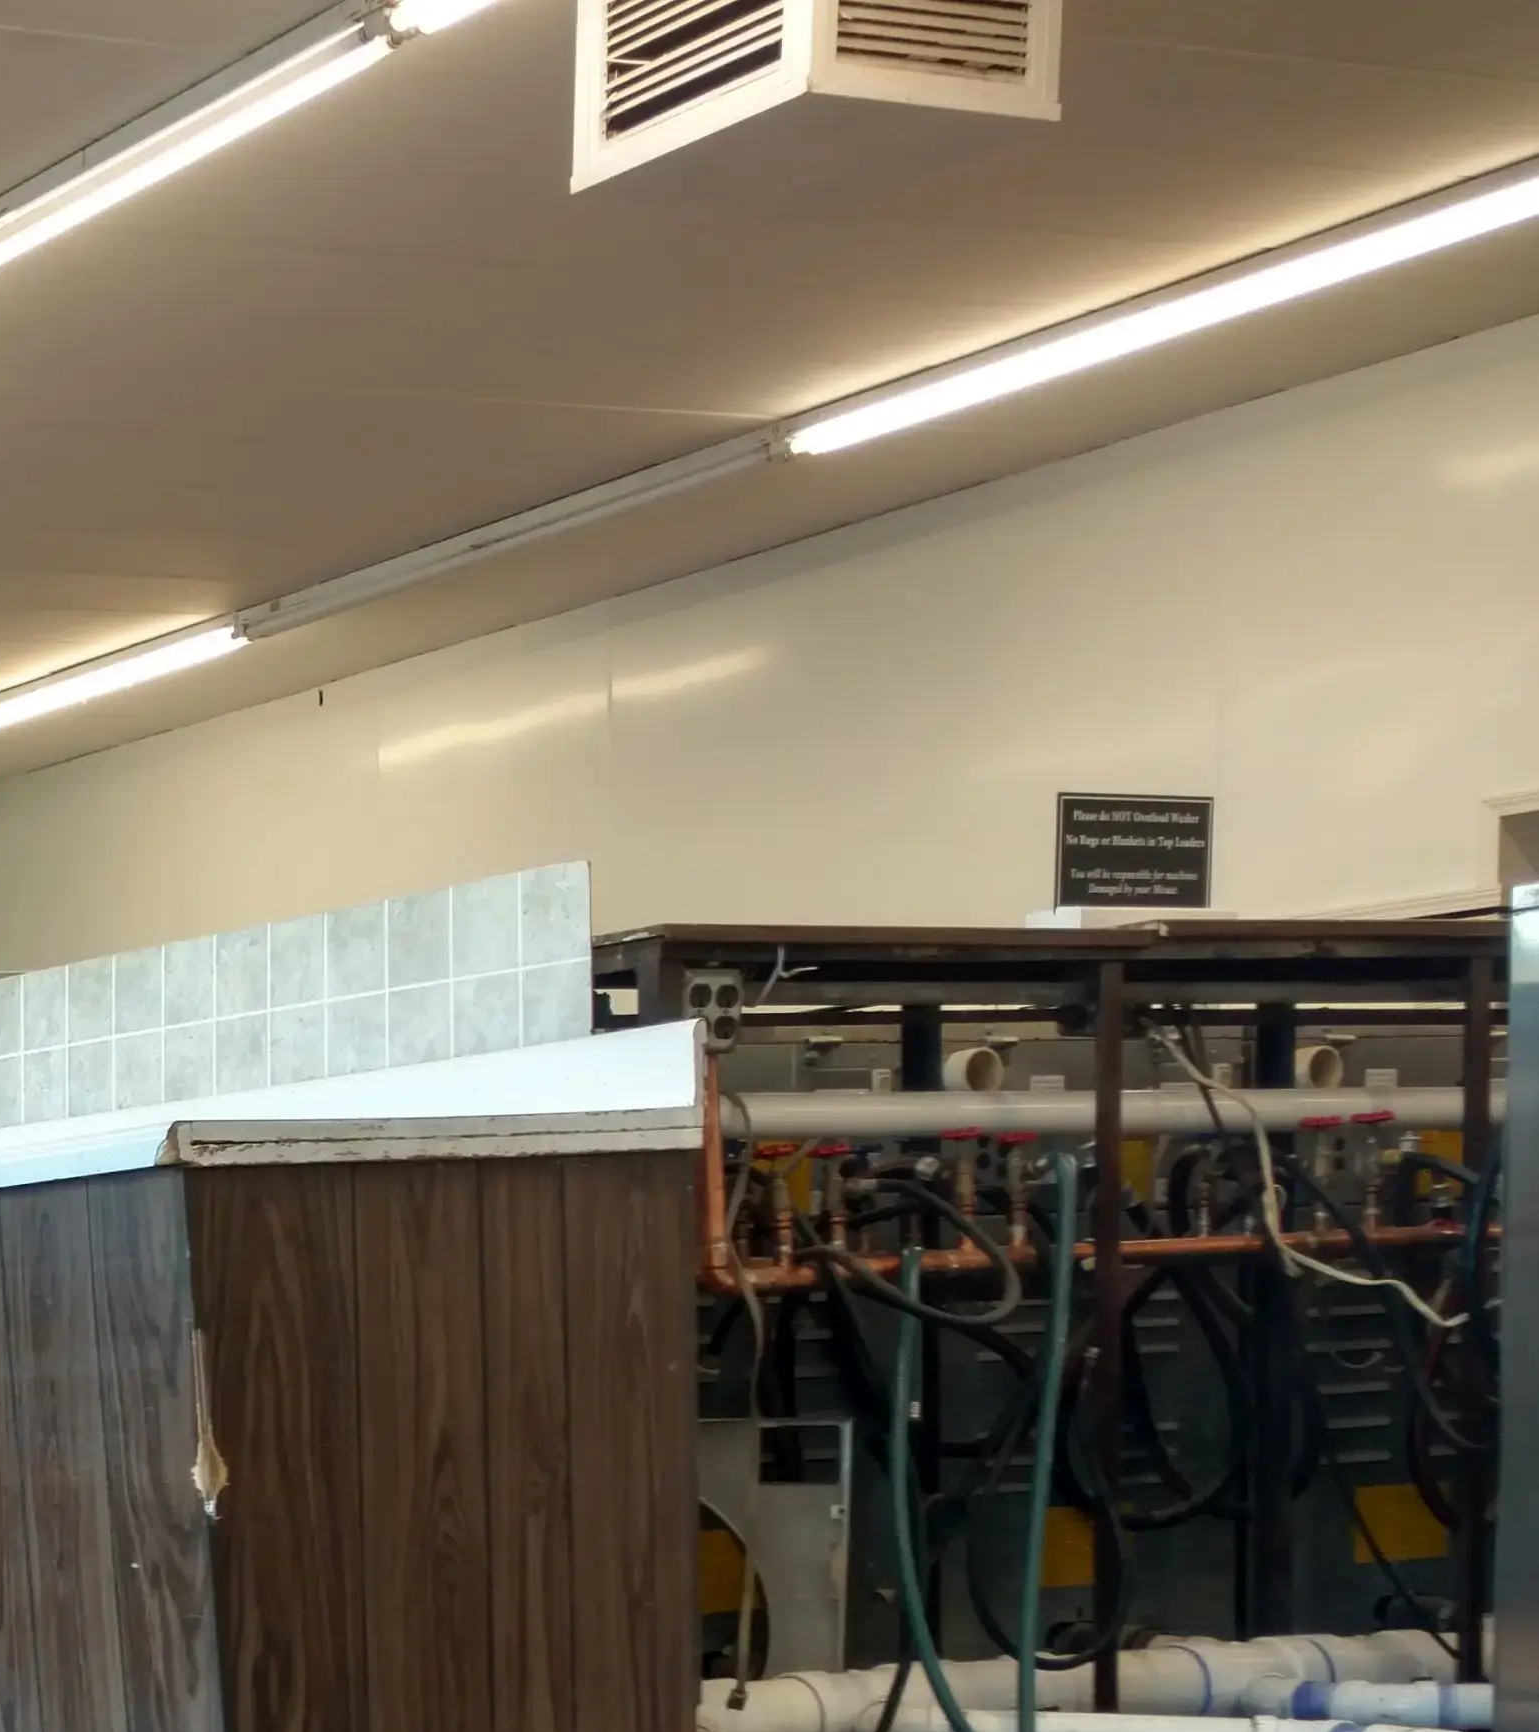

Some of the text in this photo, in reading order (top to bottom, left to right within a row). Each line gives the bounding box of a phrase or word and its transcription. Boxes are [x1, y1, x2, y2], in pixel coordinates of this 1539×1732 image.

[1073, 809, 1097, 821] Please
[1099, 810, 1110, 821] do
[1112, 810, 1132, 822] NOT
[1133, 811, 1169, 823] Overload
[1065, 834, 1078, 845] No
[1112, 835, 1145, 847] Blankets
[1157, 836, 1173, 849] Top
[1175, 837, 1205, 848] Loaders
[1070, 868, 1084, 879] You
[1086, 868, 1101, 879] will
[1112, 869, 1151, 882] responsible
[1152, 869, 1164, 882] for
[1123, 883, 1133, 897] by
